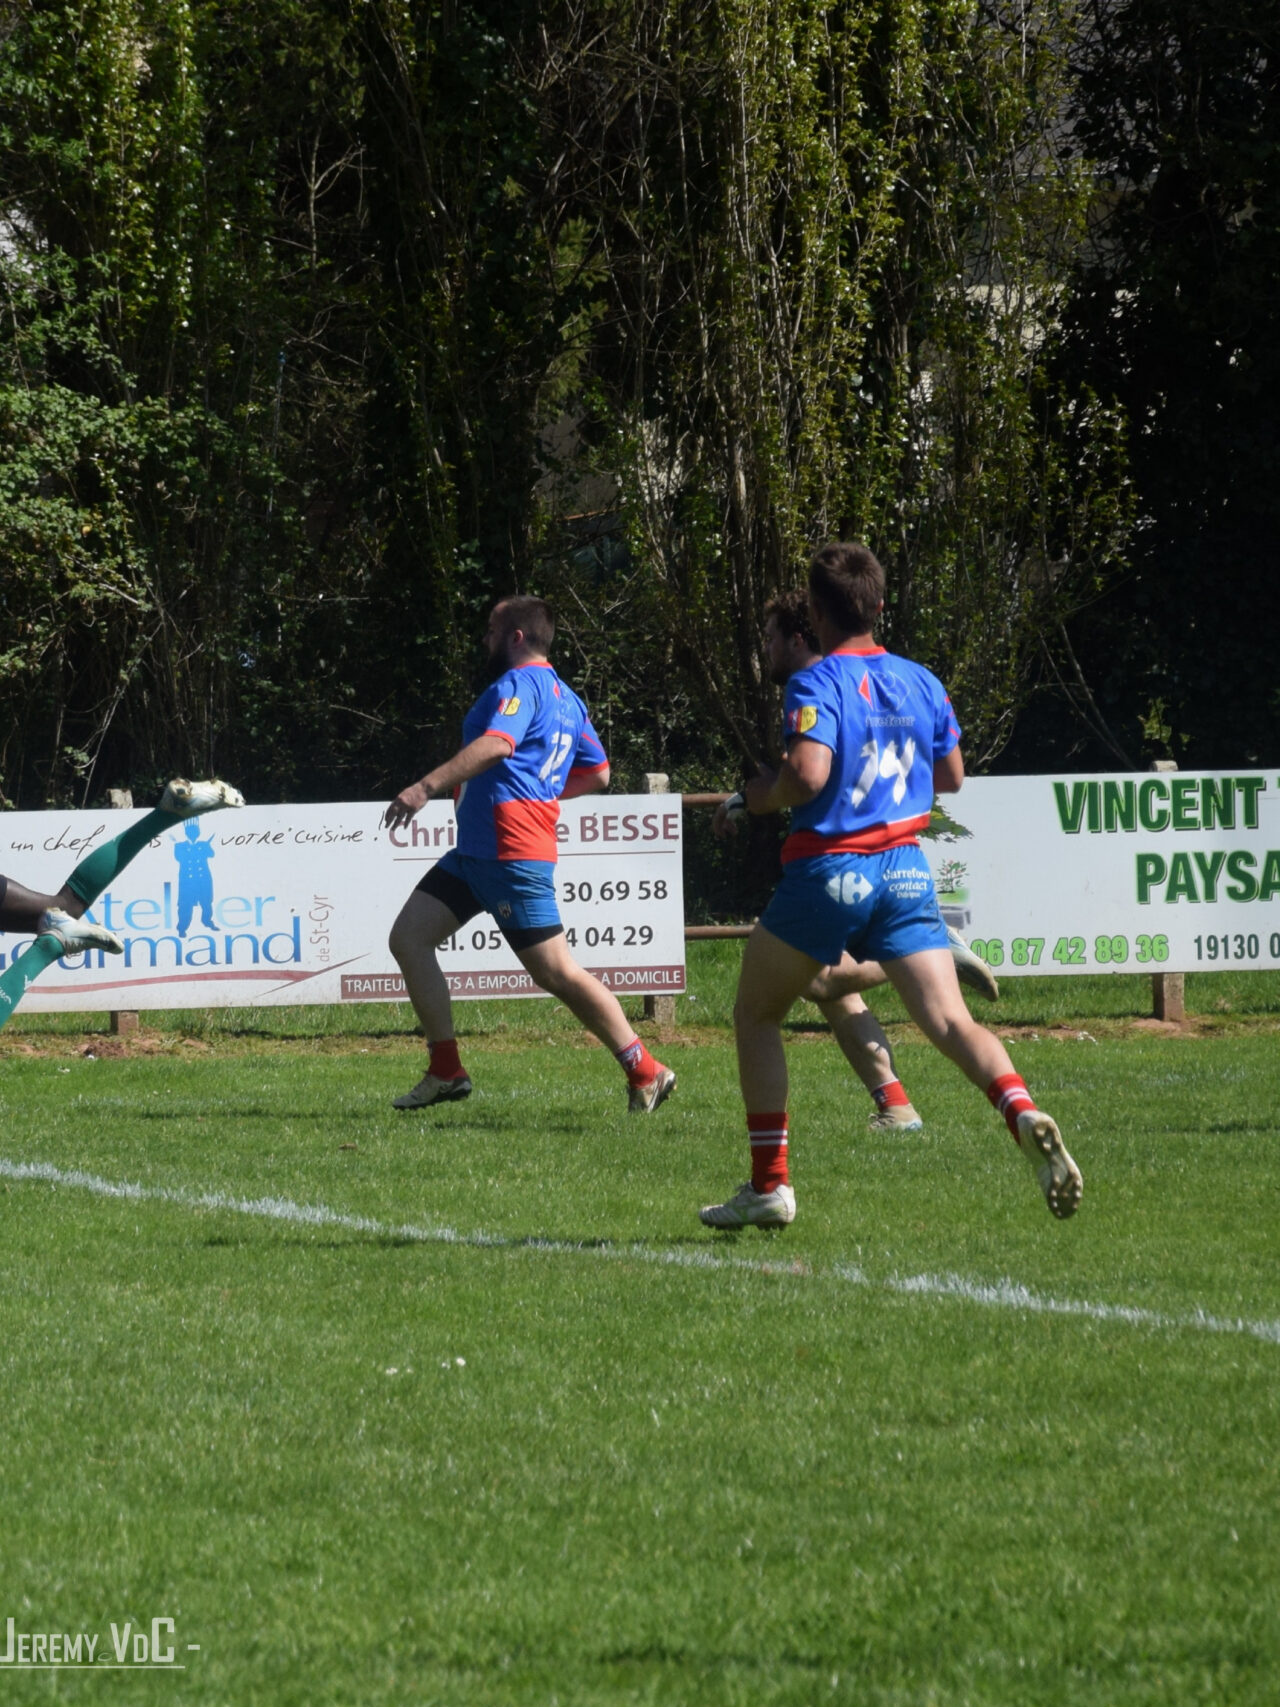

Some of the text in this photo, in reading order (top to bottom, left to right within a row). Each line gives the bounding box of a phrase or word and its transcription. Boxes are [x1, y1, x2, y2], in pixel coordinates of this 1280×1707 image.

[851, 736, 916, 809] 14
[1052, 777, 1266, 834] VINCENT
[11, 841, 34, 852] un
[43, 824, 106, 861] chef
[294, 825, 363, 845] cuisine
[580, 814, 680, 842] BESSE
[563, 880, 668, 902] 30 69 58
[309, 894, 335, 944] St-Cyr
[471, 930, 502, 951] 05
[585, 926, 616, 947] 04
[623, 925, 654, 946] 29
[971, 938, 1005, 967] 06
[1011, 937, 1046, 966] 87
[1052, 936, 1087, 965] 42
[1094, 935, 1129, 964] 89
[1135, 934, 1170, 963] 36
[1194, 933, 1260, 960] 19130
[344, 978, 407, 993] TRAITEU
[478, 974, 534, 989] EMPORT
[614, 970, 682, 985] DOMICILE
